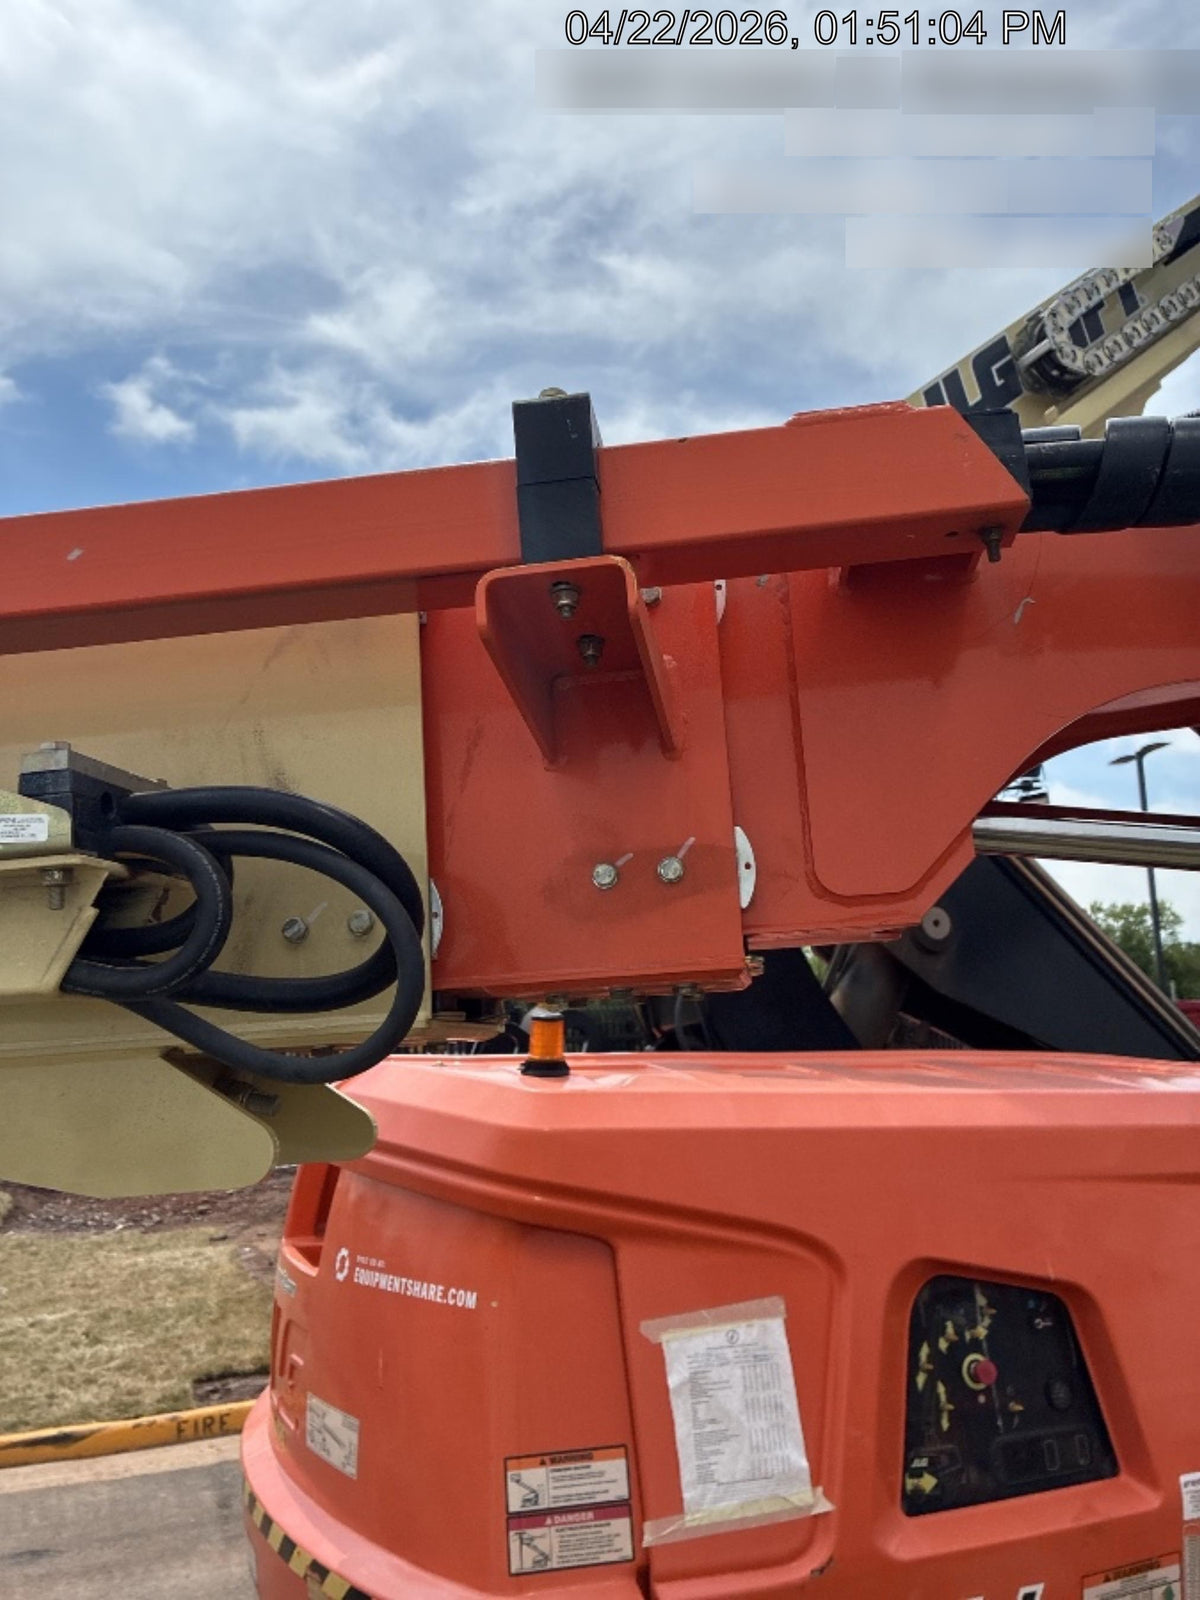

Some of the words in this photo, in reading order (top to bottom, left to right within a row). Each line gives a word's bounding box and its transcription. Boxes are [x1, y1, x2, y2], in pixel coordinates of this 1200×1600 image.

[353, 1267, 478, 1309] EQUIPMENTSHARE.COM
[176, 1412, 231, 1440] FIRE
[554, 1511, 595, 1524] DANGER
